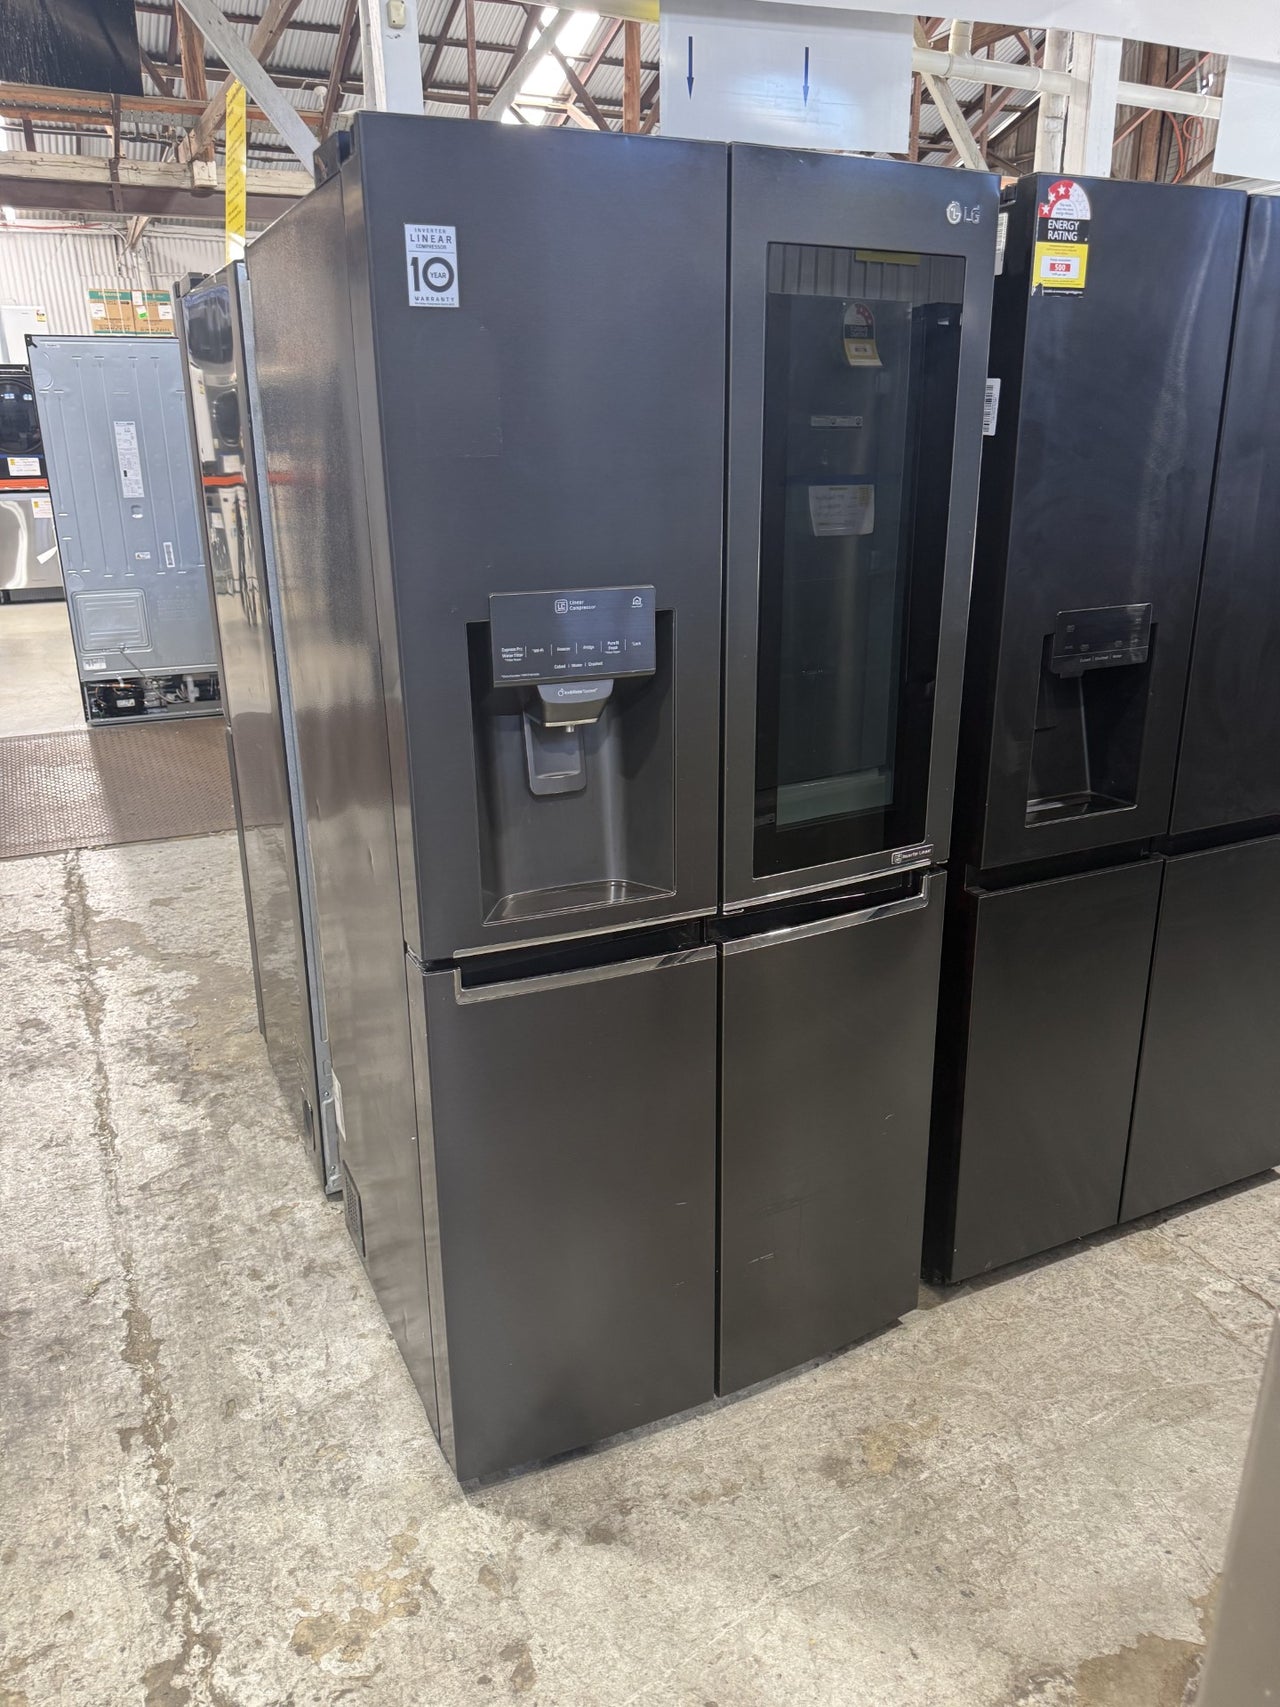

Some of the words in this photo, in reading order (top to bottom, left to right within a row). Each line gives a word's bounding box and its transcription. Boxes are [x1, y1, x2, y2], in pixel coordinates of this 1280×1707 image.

[963, 205, 980, 224] LG
[1048, 220, 1080, 230] ENERGY
[410, 234, 452, 244] LINEAR
[1048, 230, 1078, 241] RATING
[410, 257, 454, 293] 10
